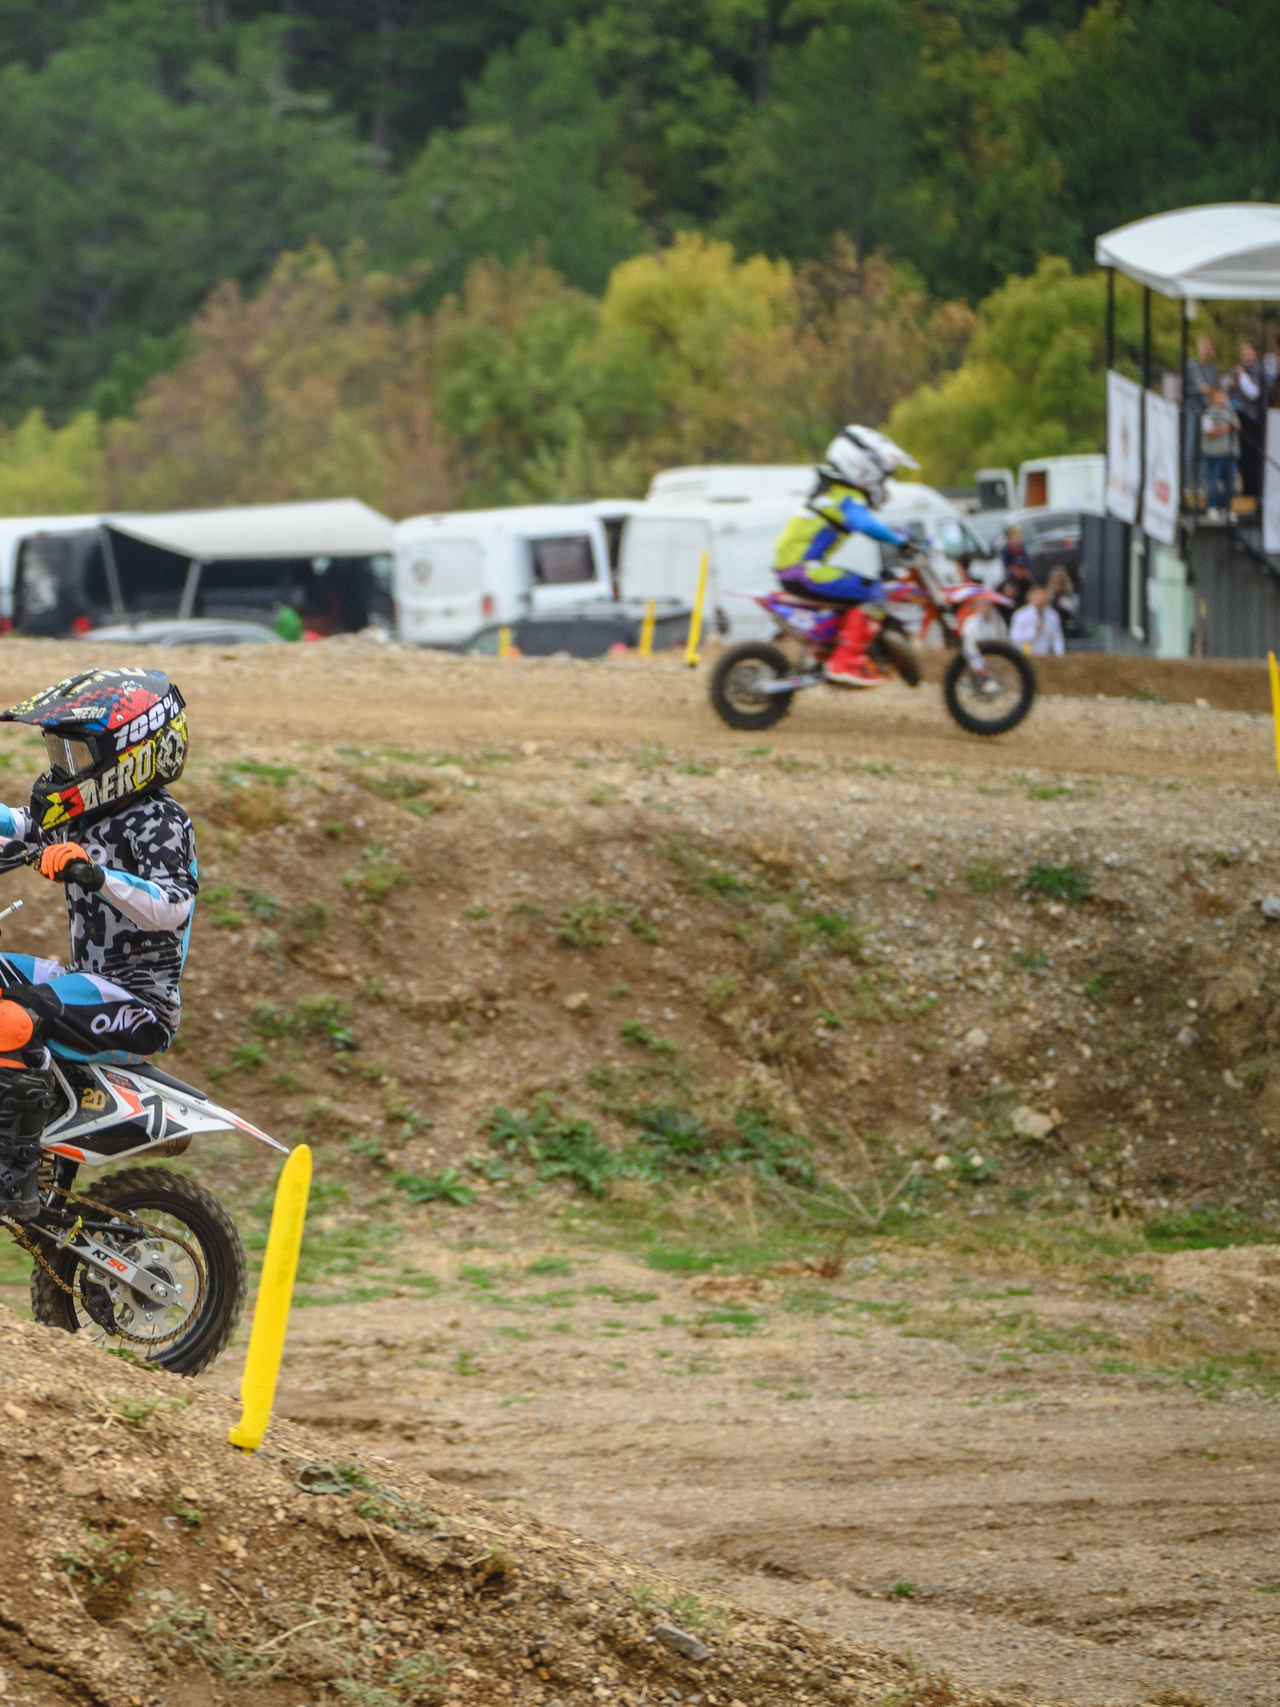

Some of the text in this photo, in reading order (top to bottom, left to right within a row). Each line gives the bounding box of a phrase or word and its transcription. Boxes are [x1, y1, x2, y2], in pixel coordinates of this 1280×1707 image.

[72, 706, 106, 719] AERO
[114, 693, 179, 752] 100%
[78, 742, 152, 812] AERO
[91, 1248, 129, 1273] KT50
